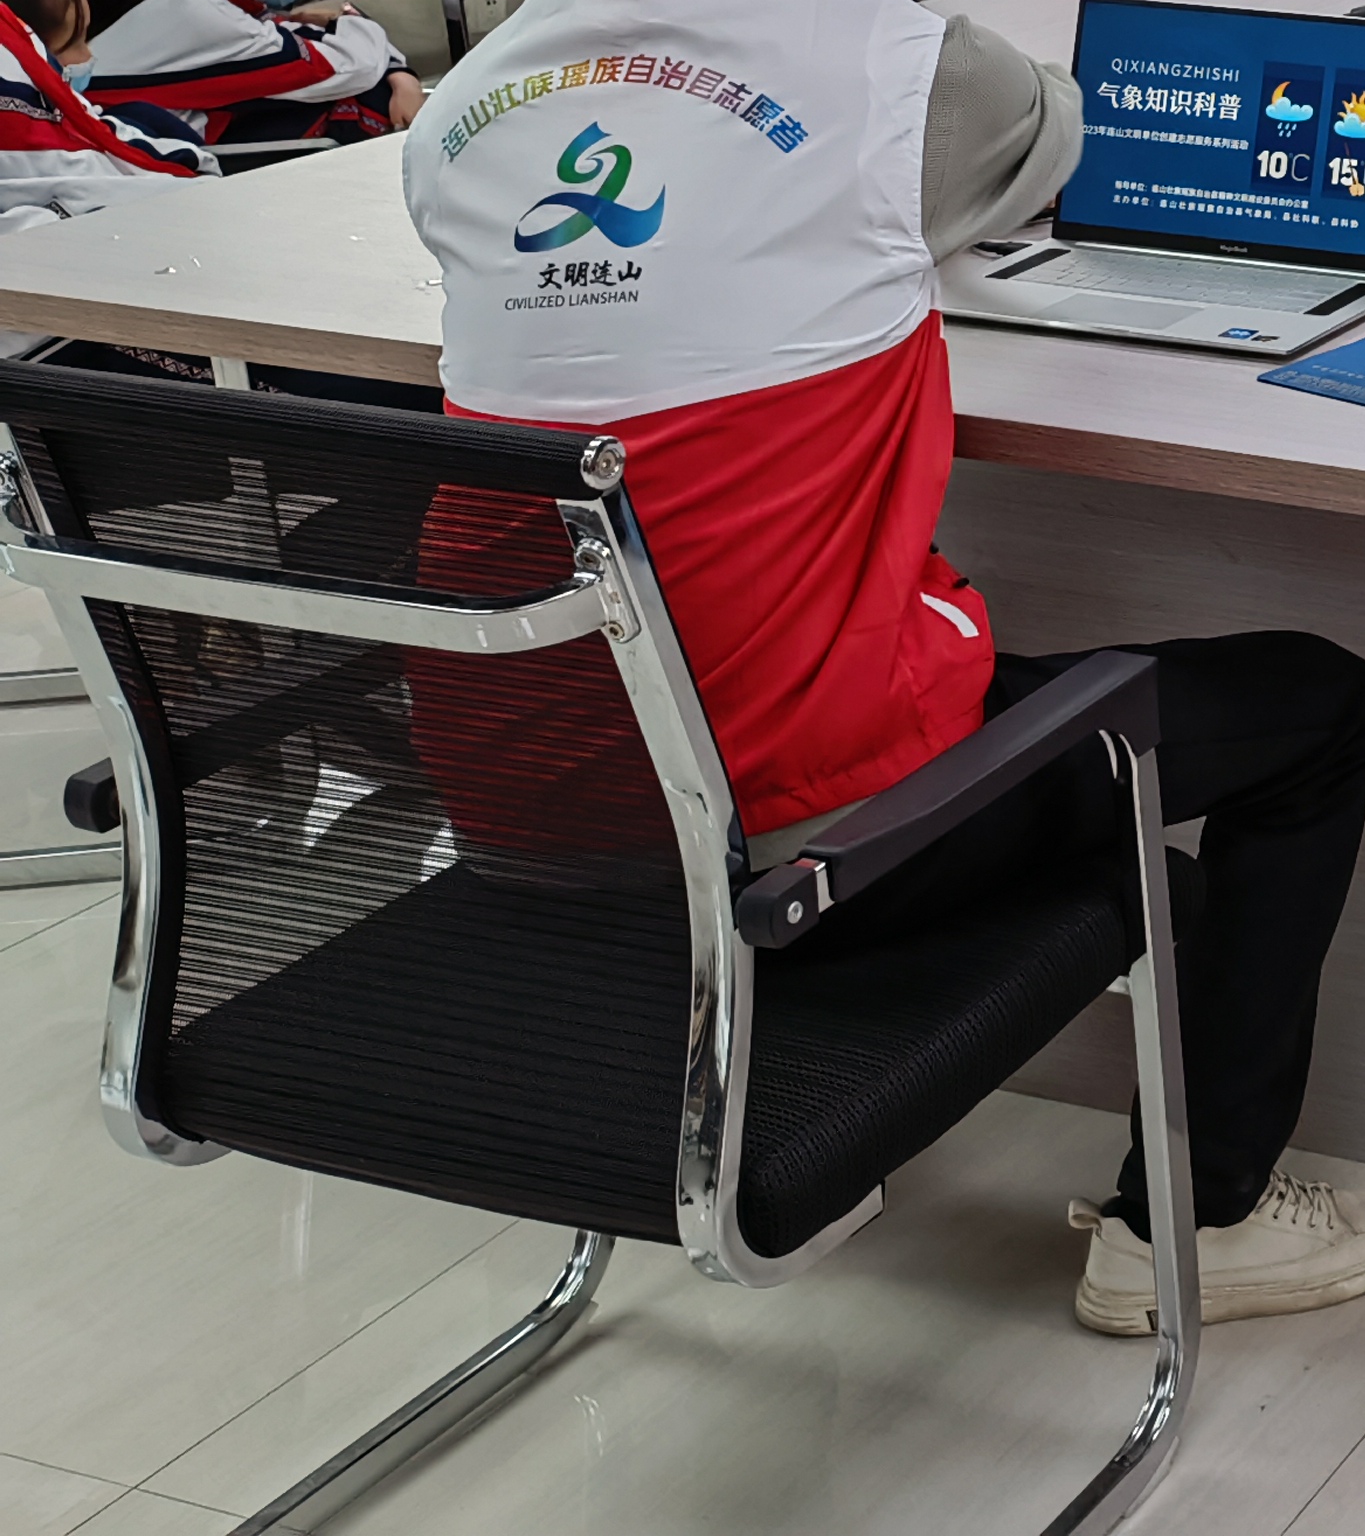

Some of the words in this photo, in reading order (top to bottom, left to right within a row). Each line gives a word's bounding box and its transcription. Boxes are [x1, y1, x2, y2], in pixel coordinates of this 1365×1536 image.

[1111, 58, 1240, 83] QIXIANGZHISHI
[441, 54, 809, 163] 连山壮族瑶族自治县志愿者
[1097, 81, 1242, 121] 气象知识科普
[538, 261, 643, 290] 文明连山
[504, 295, 565, 311] CIVILIZED
[568, 290, 639, 307] LIANSHAN
